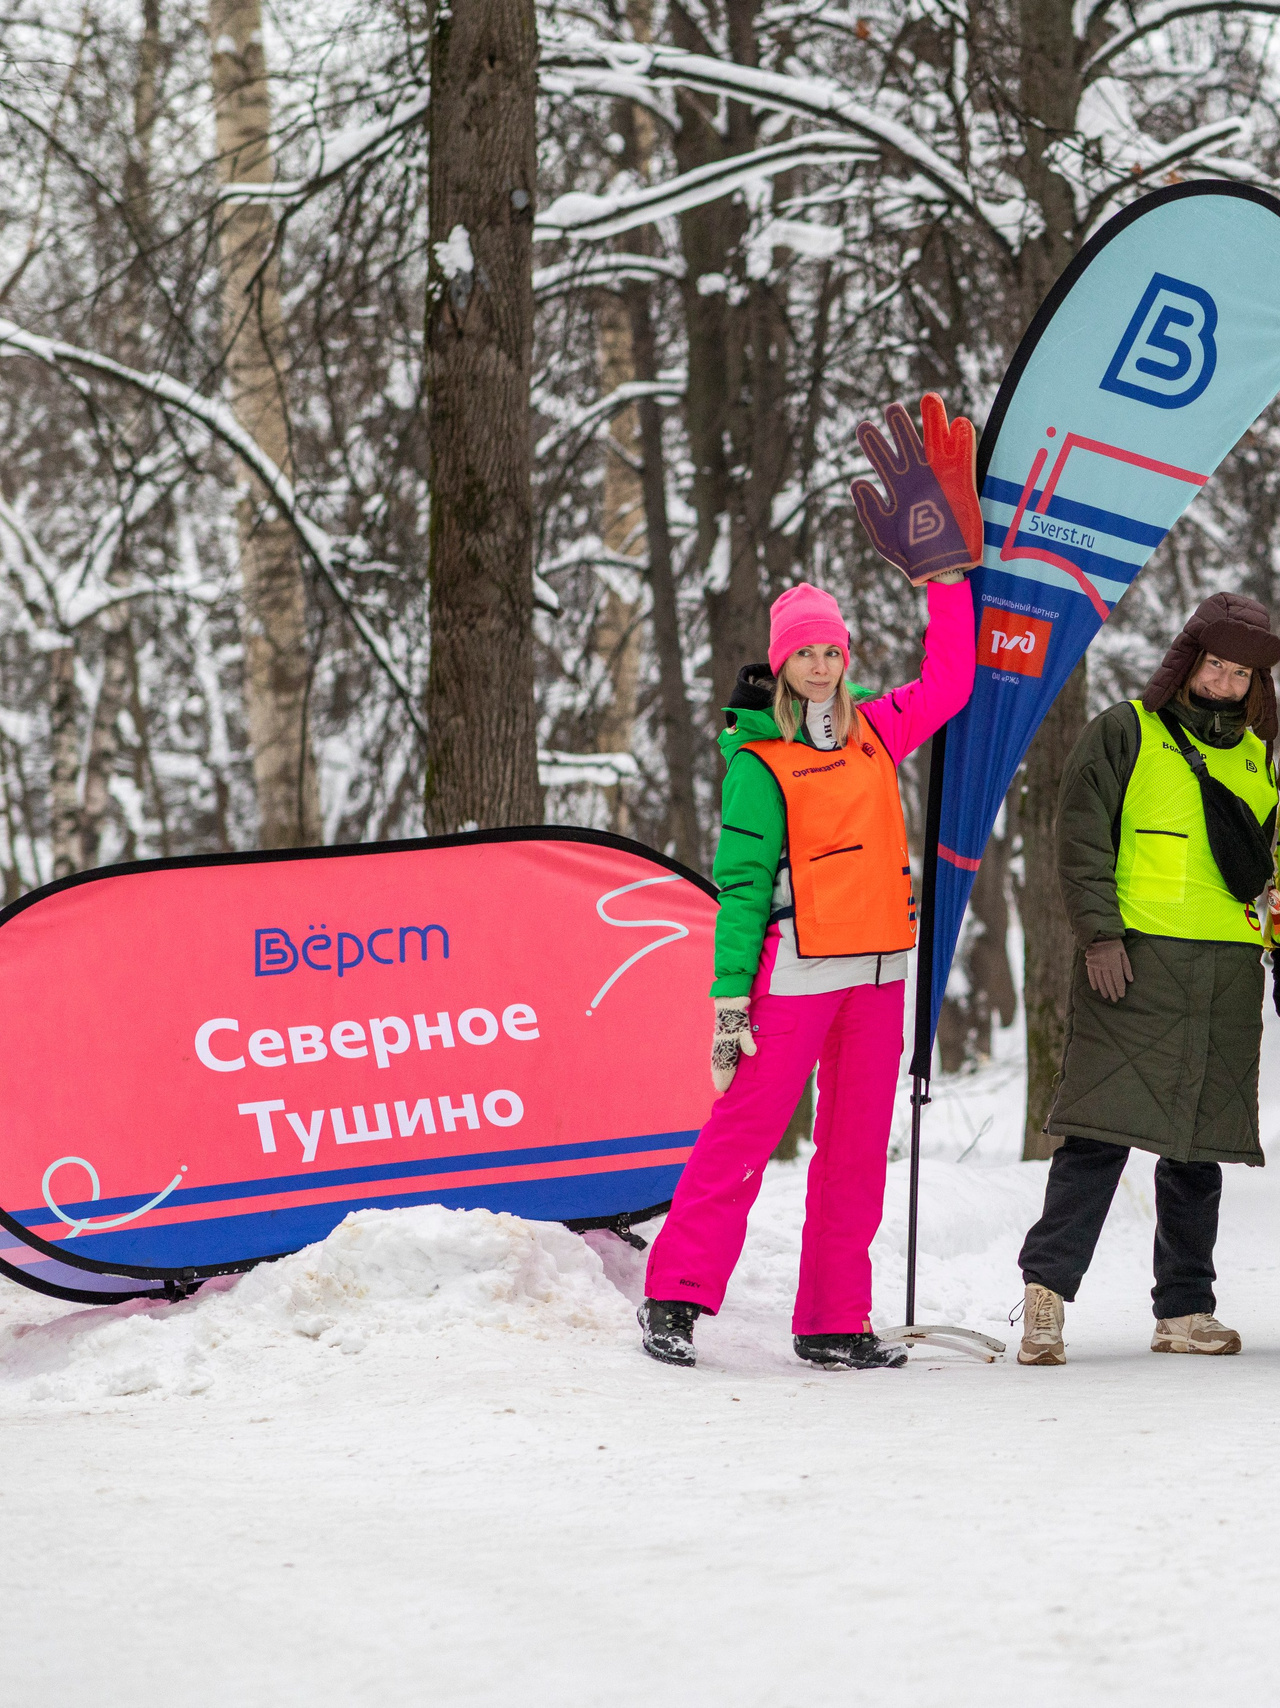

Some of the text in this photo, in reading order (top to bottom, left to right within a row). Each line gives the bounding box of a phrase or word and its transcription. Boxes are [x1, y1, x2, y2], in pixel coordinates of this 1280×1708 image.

[1028, 515, 1096, 549] 5verst.ru
[792, 758, 847, 778] Организатор
[194, 1003, 541, 1072] Северное
[237, 1089, 525, 1163] Тушино
